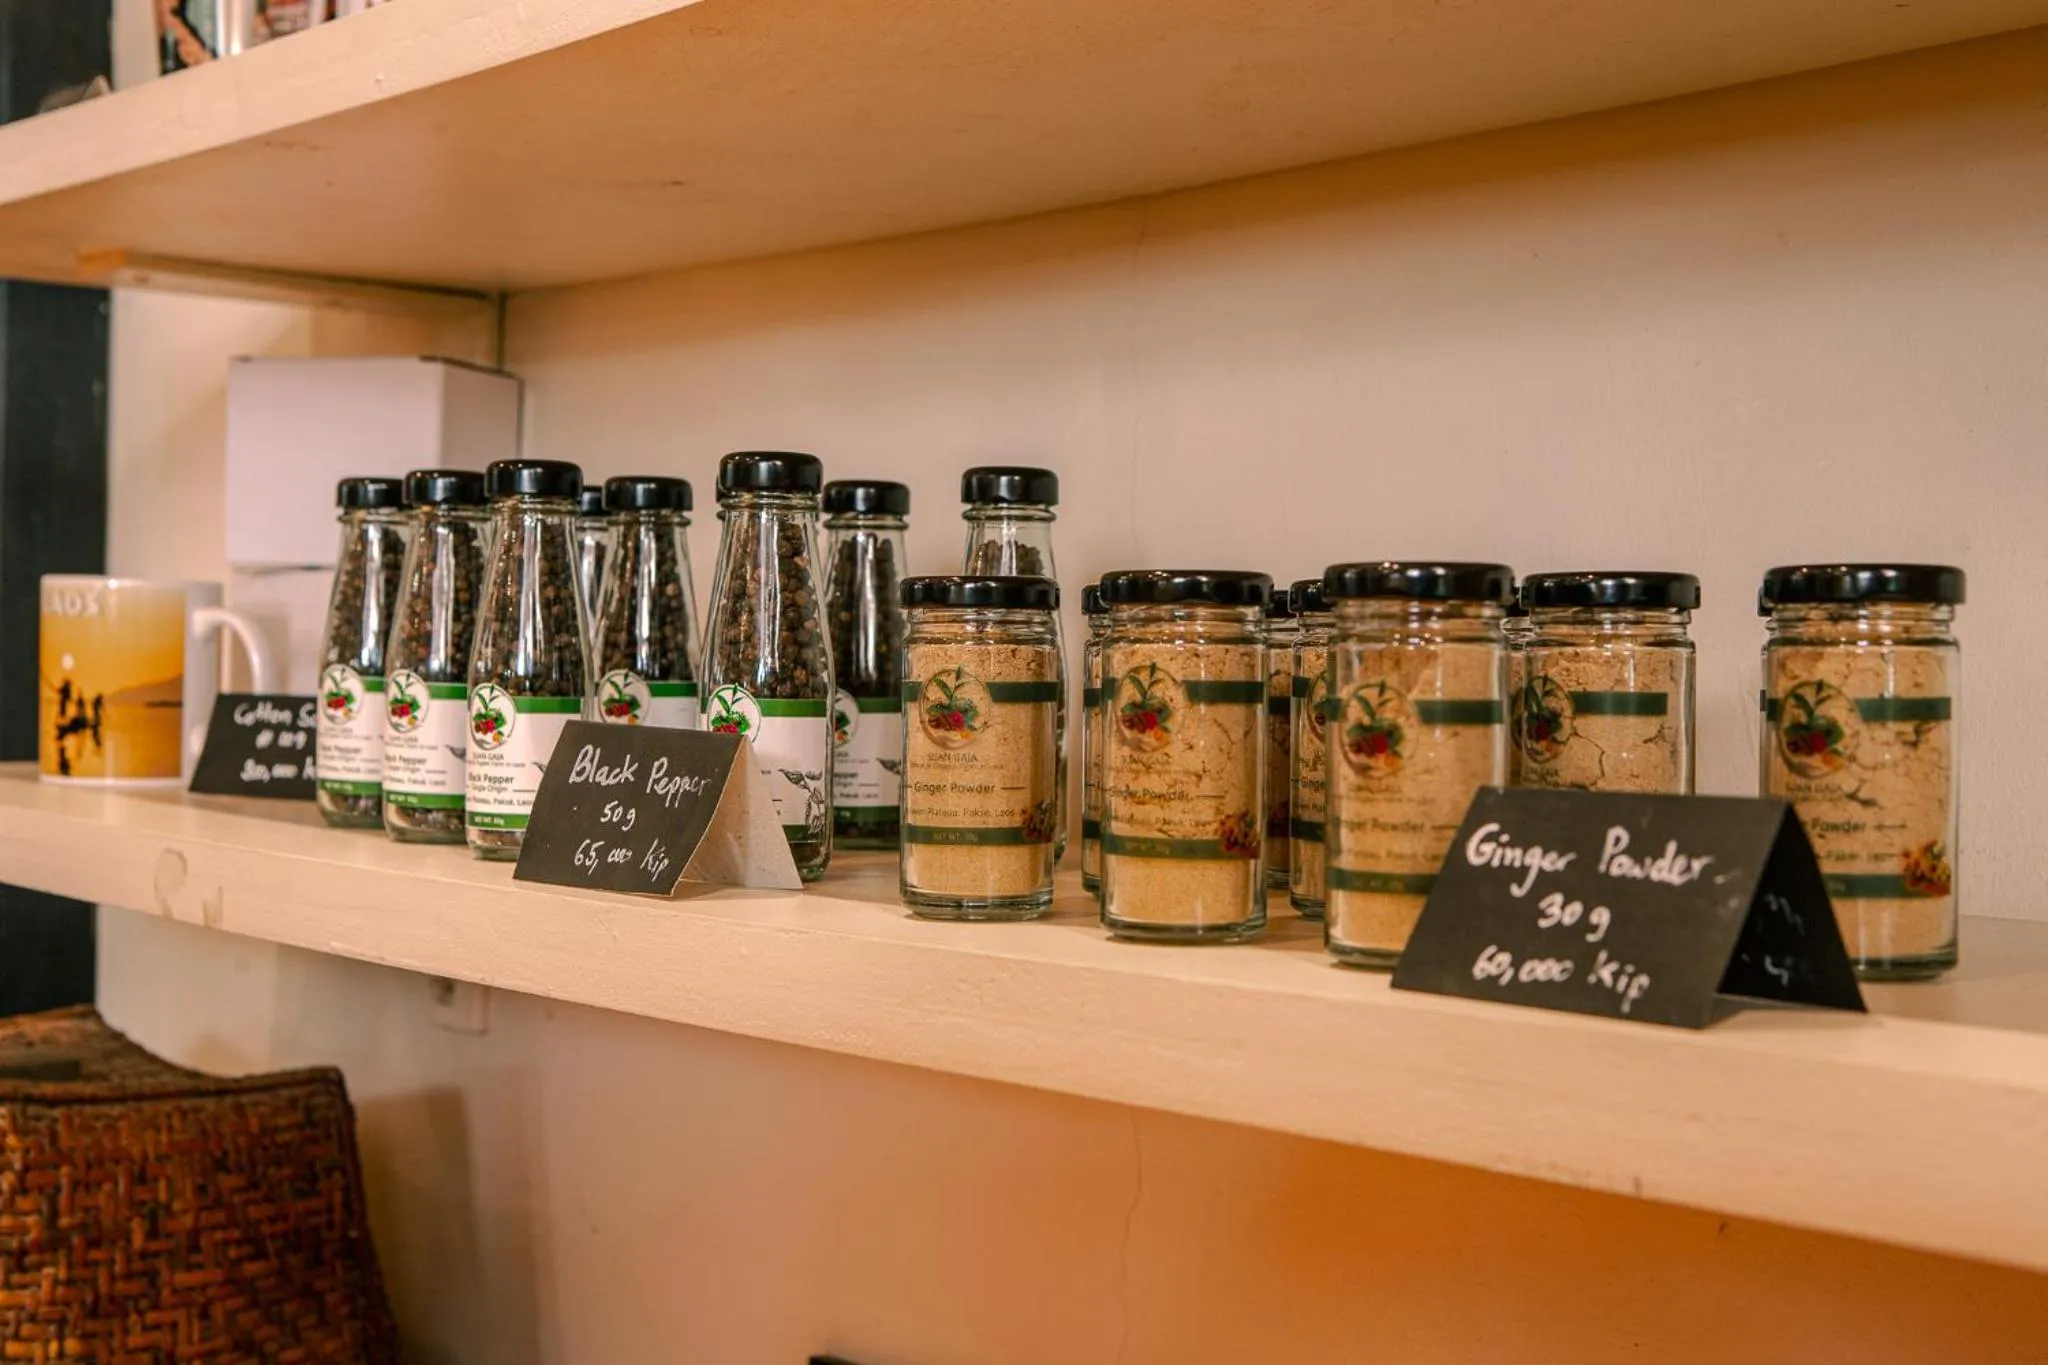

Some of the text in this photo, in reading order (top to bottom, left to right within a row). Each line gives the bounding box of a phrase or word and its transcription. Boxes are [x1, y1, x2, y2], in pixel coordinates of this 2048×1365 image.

[483, 774, 514, 785] Pepper
[568, 744, 712, 808] Black Pepper
[913, 781, 997, 796] Ginger Powder
[1465, 822, 1715, 897] Ginger Powder
